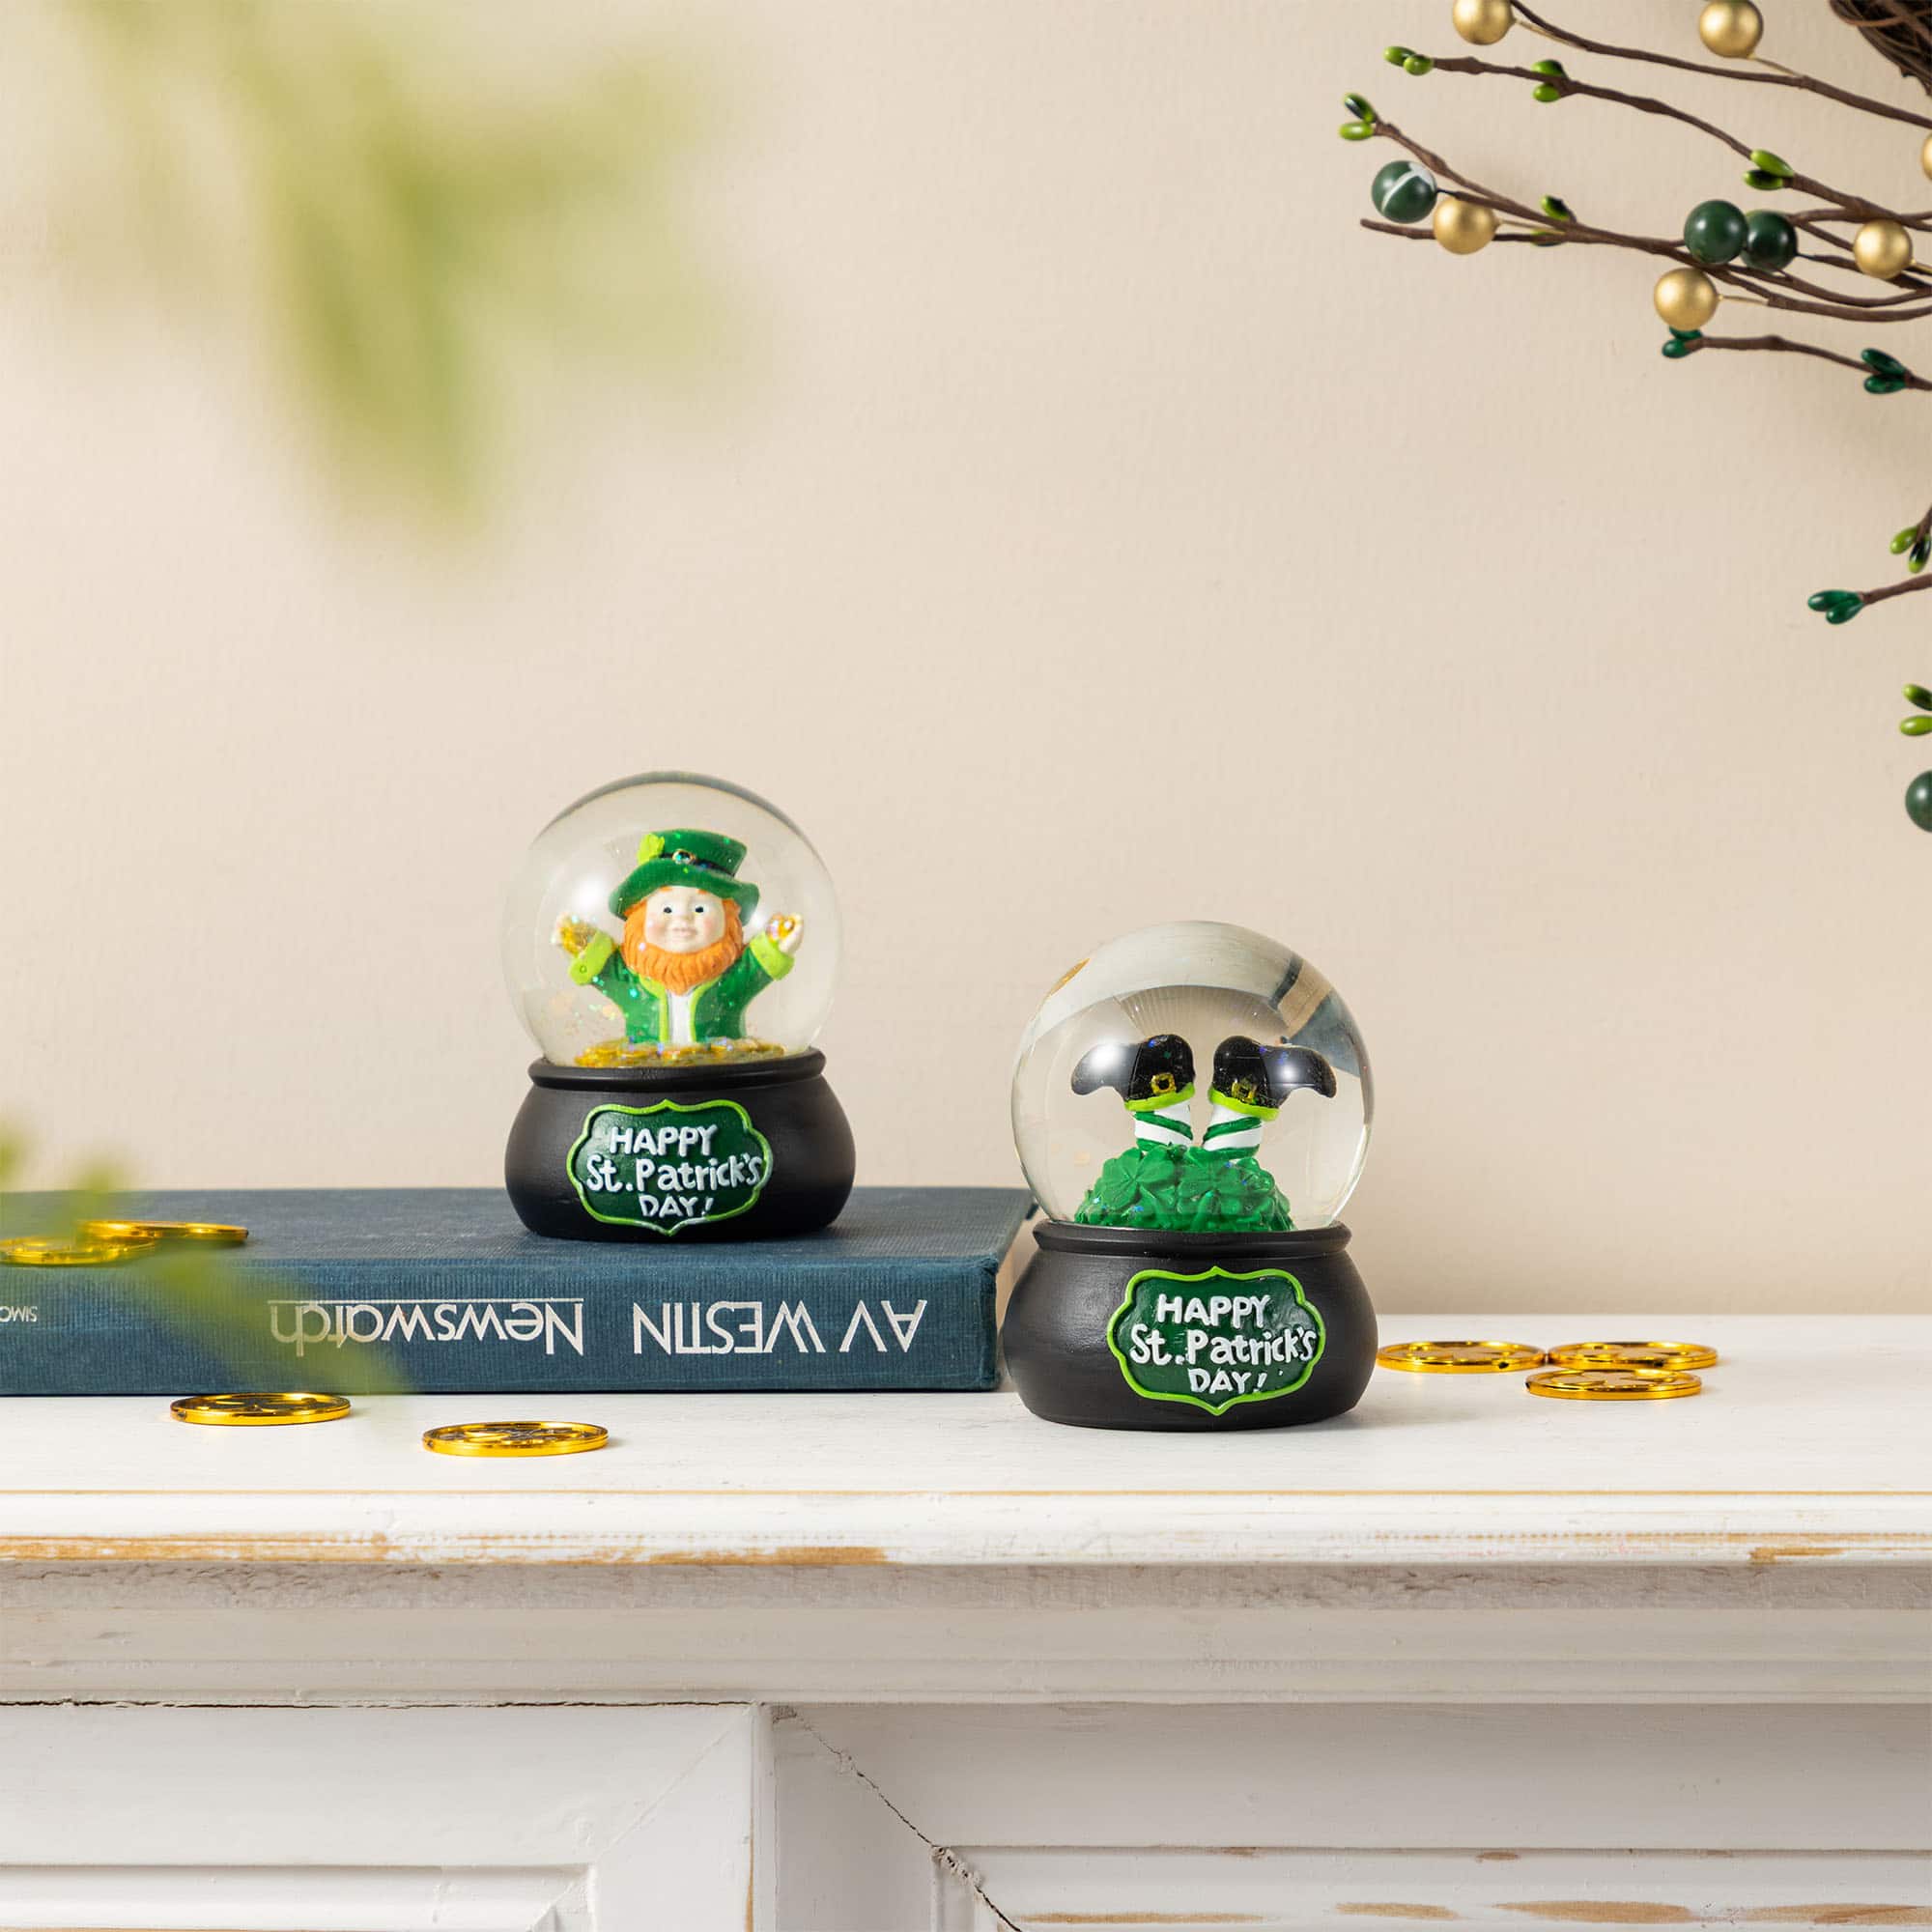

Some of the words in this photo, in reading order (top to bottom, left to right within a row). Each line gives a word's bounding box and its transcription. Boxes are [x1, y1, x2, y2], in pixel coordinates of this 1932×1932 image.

[609, 1124, 719, 1157] HAPPY
[639, 1193, 715, 1218] DAY!
[633, 1300, 827, 1354] WESTIN
[838, 1300, 927, 1353] AV
[1155, 1293, 1271, 1328] HAPPY
[269, 1300, 584, 1357] Newswatch
[1187, 1367, 1268, 1394] DAY!
